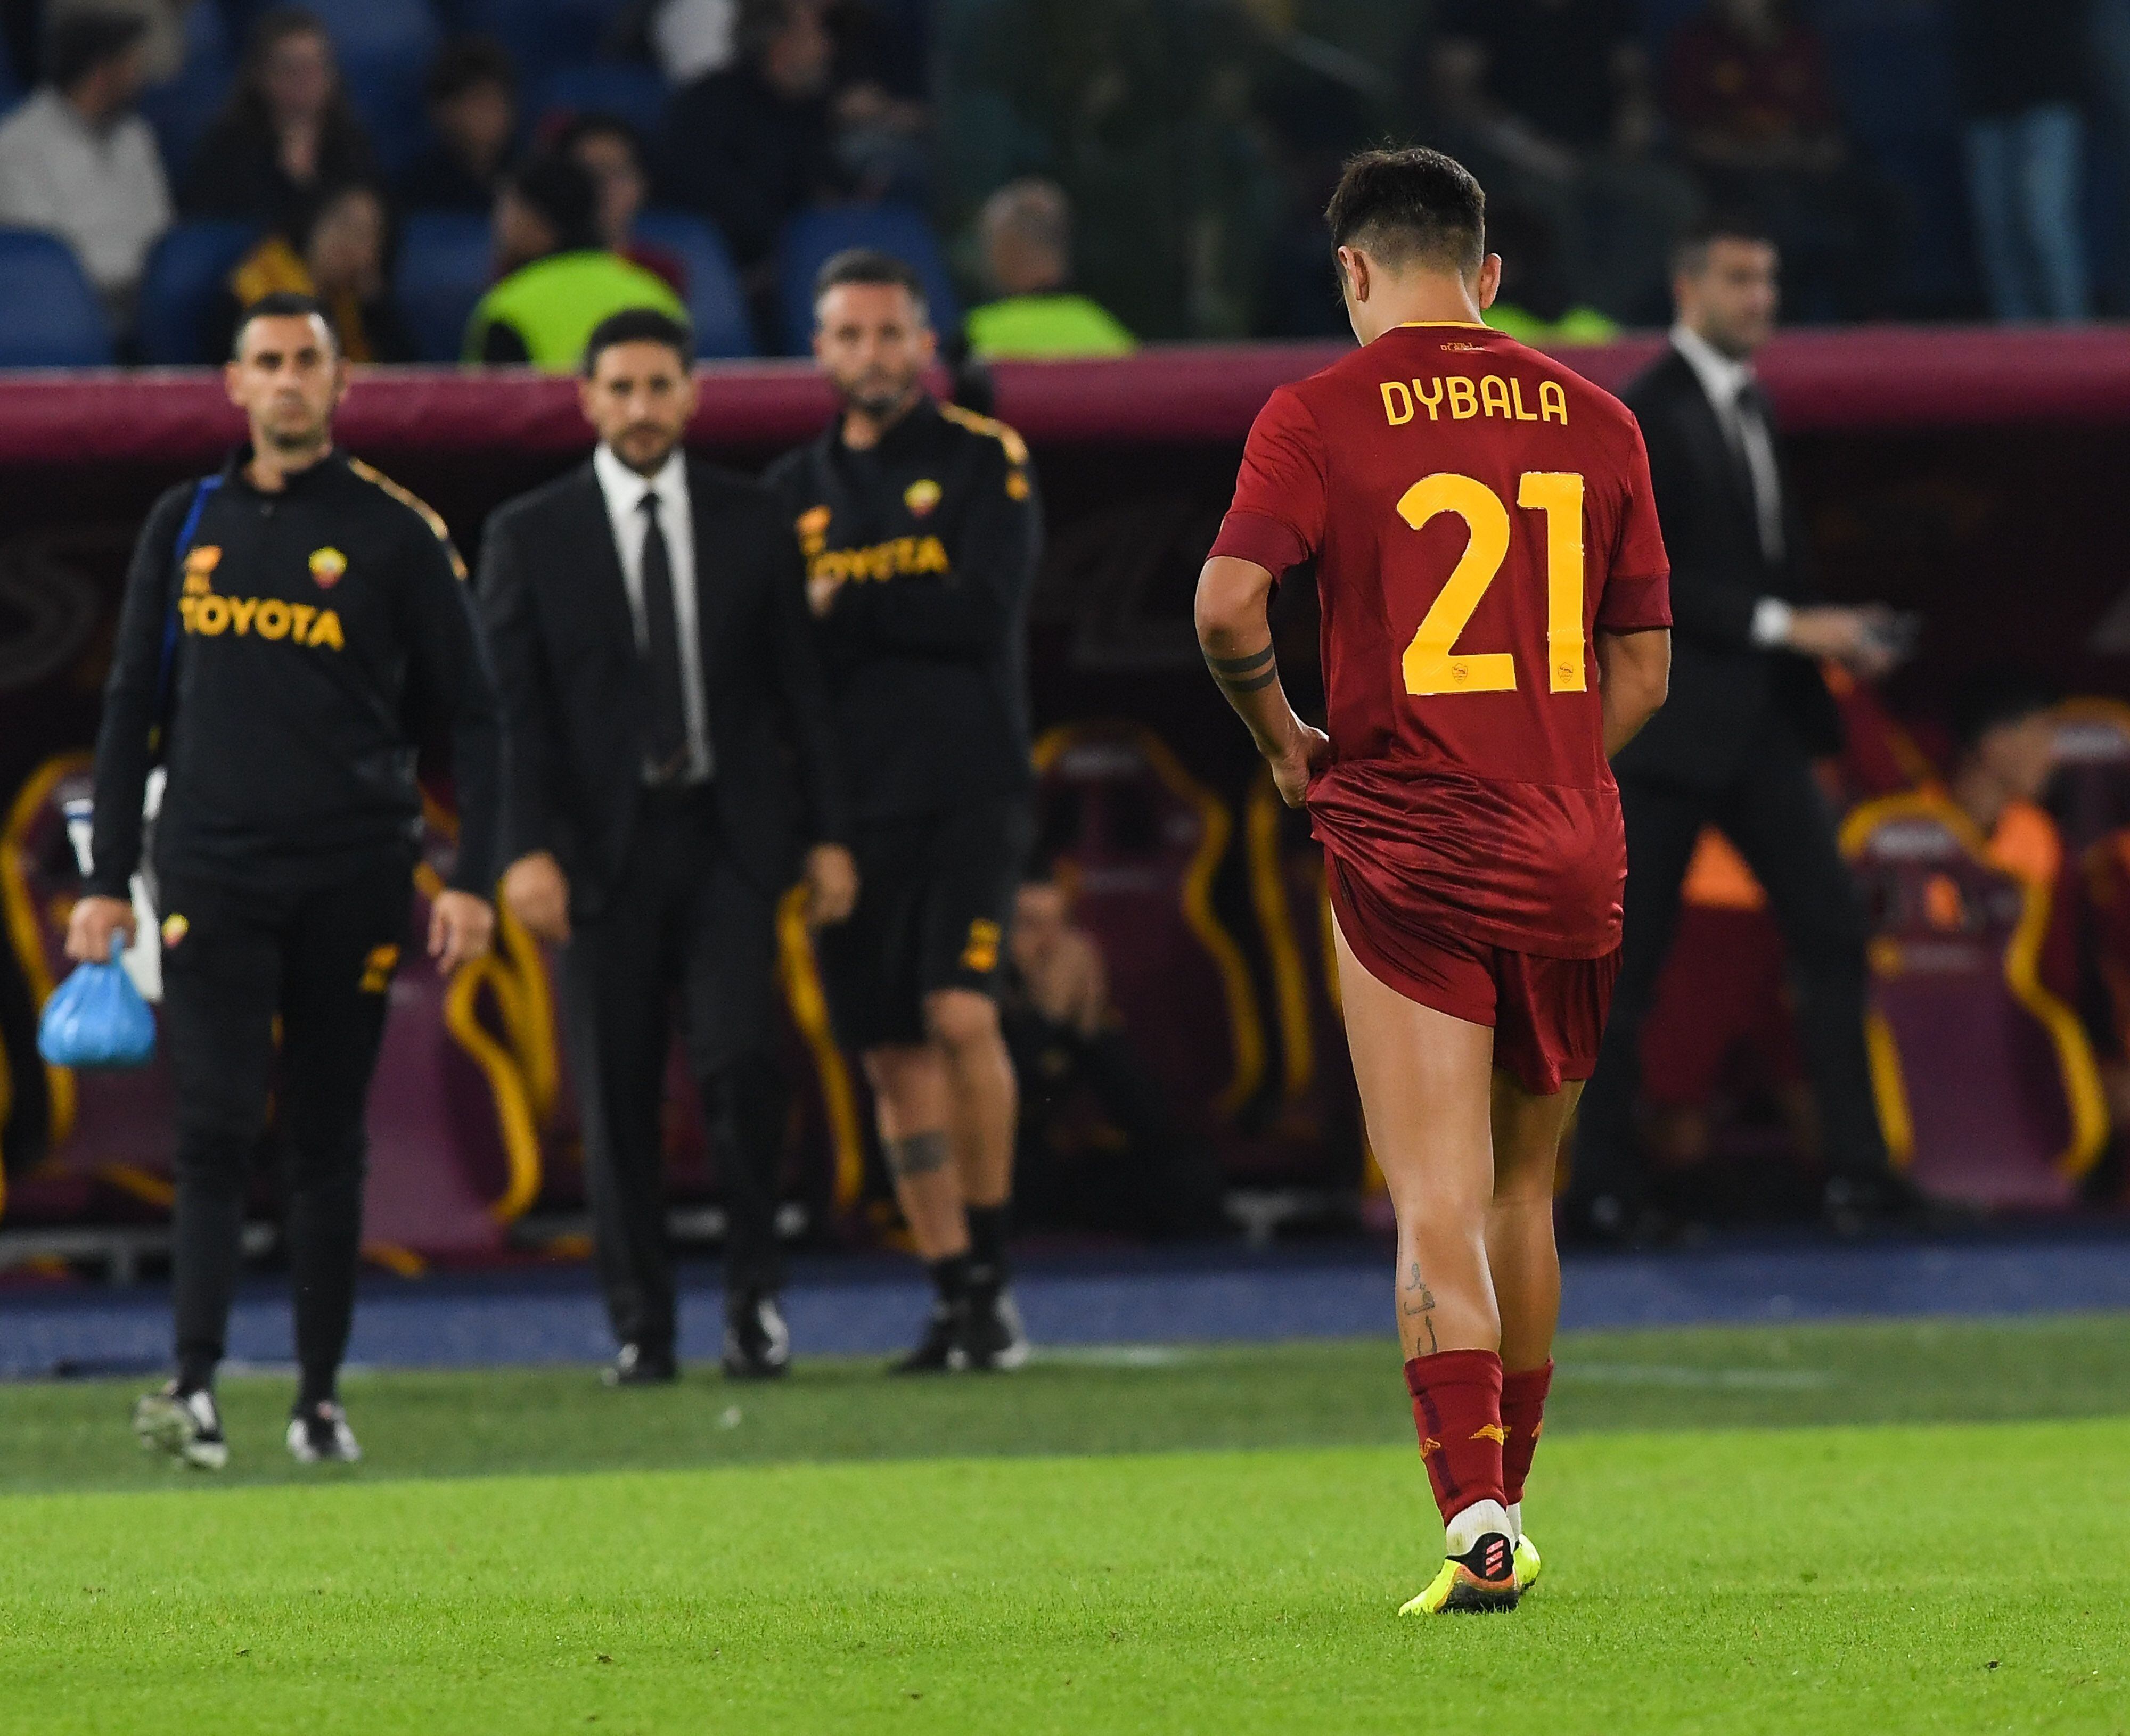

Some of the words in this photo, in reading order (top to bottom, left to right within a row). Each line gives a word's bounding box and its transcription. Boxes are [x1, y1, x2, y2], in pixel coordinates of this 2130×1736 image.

[1380, 375, 1568, 426] DYBALA
[1396, 472, 1587, 694] 21
[178, 594, 345, 651] TOYOTA
